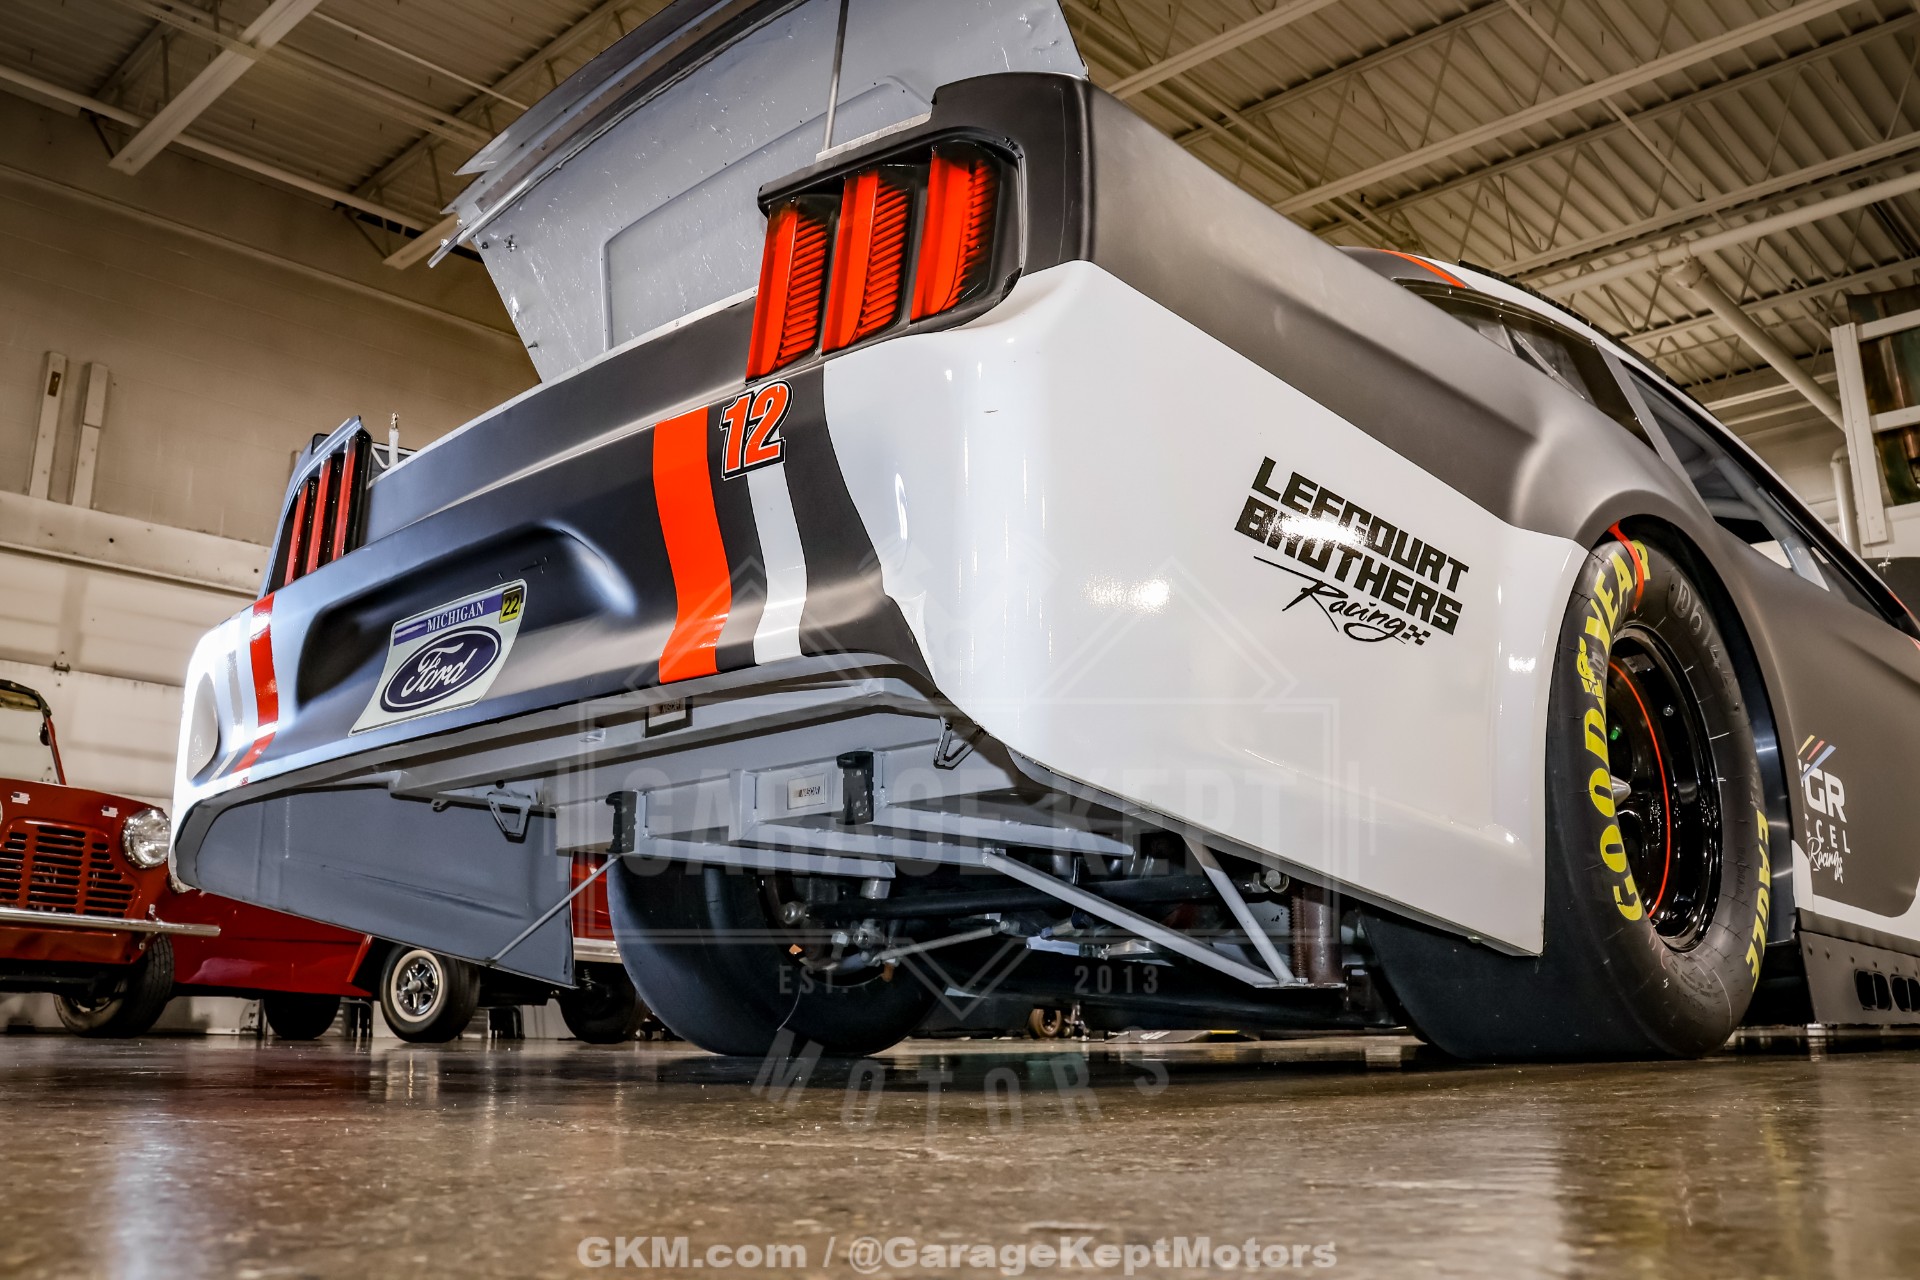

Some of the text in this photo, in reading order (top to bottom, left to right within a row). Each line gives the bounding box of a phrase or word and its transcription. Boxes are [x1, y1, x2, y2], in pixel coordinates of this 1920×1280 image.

[720, 380, 793, 481] 12
[1251, 456, 1469, 593] LEFCOURT
[427, 600, 485, 633] MICHIGAN
[502, 594, 520, 617] 22
[1253, 555, 1406, 645] Racing
[401, 642, 478, 698] Ford
[1745, 809, 1770, 993] EAGLE
